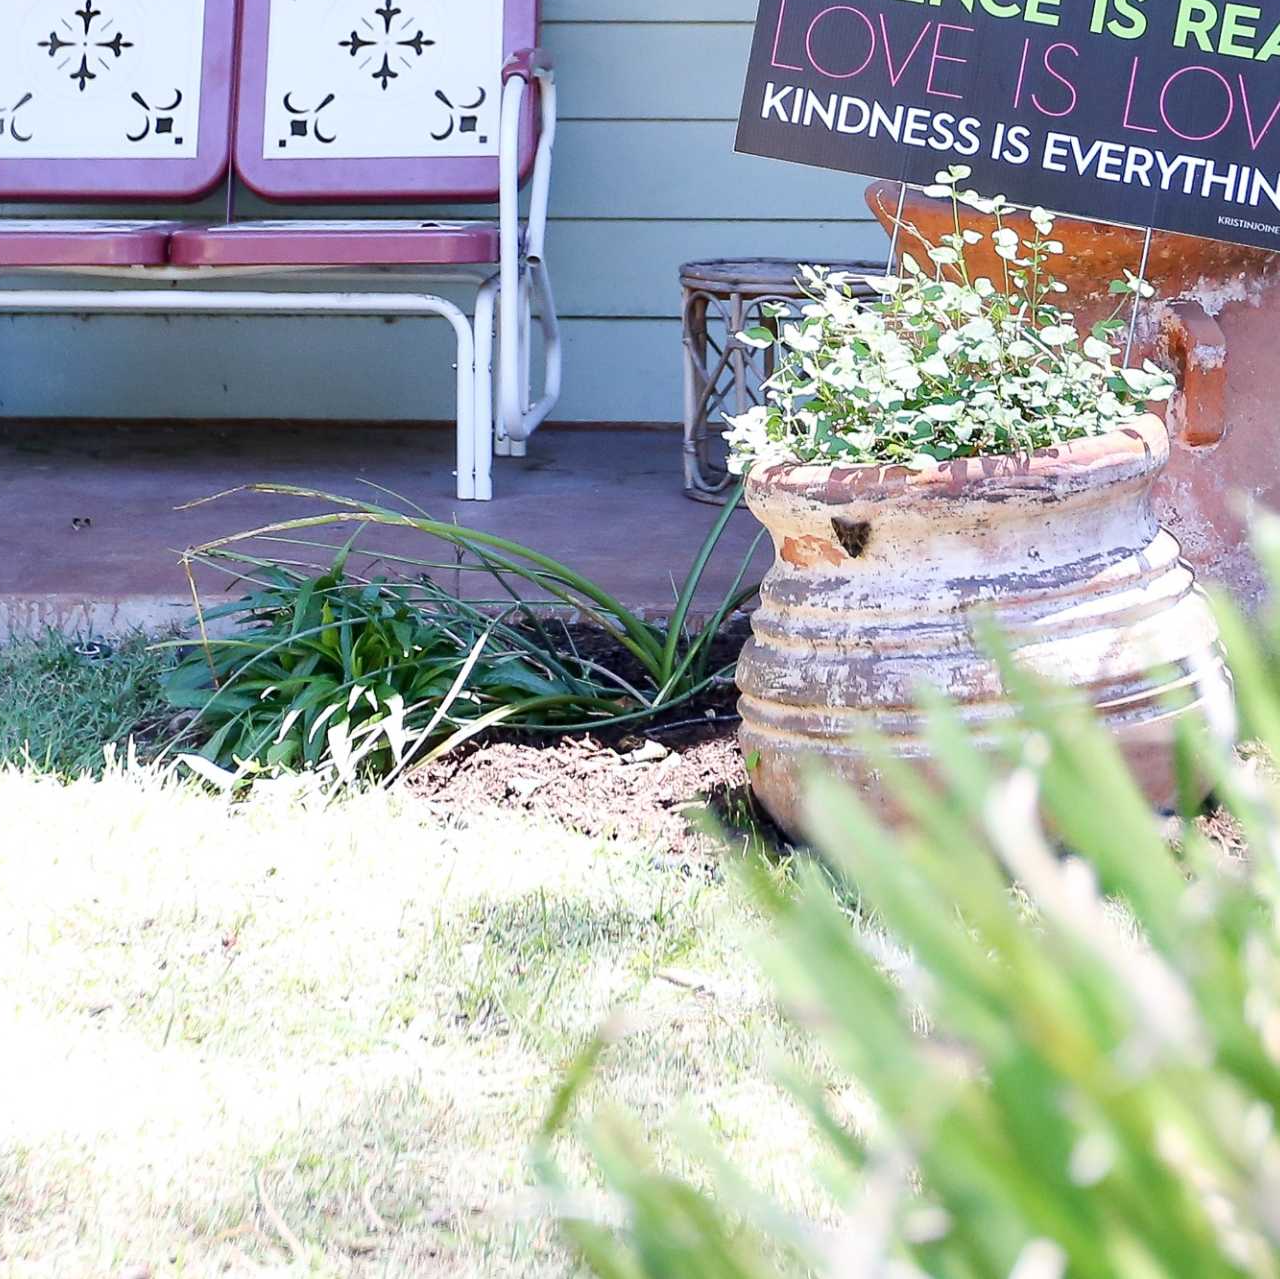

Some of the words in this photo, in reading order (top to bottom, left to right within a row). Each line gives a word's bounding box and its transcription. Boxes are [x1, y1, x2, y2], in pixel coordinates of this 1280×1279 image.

[1013, 38, 1079, 117] IS
[761, 82, 980, 155] KINDNESS
[991, 122, 1031, 164] IS
